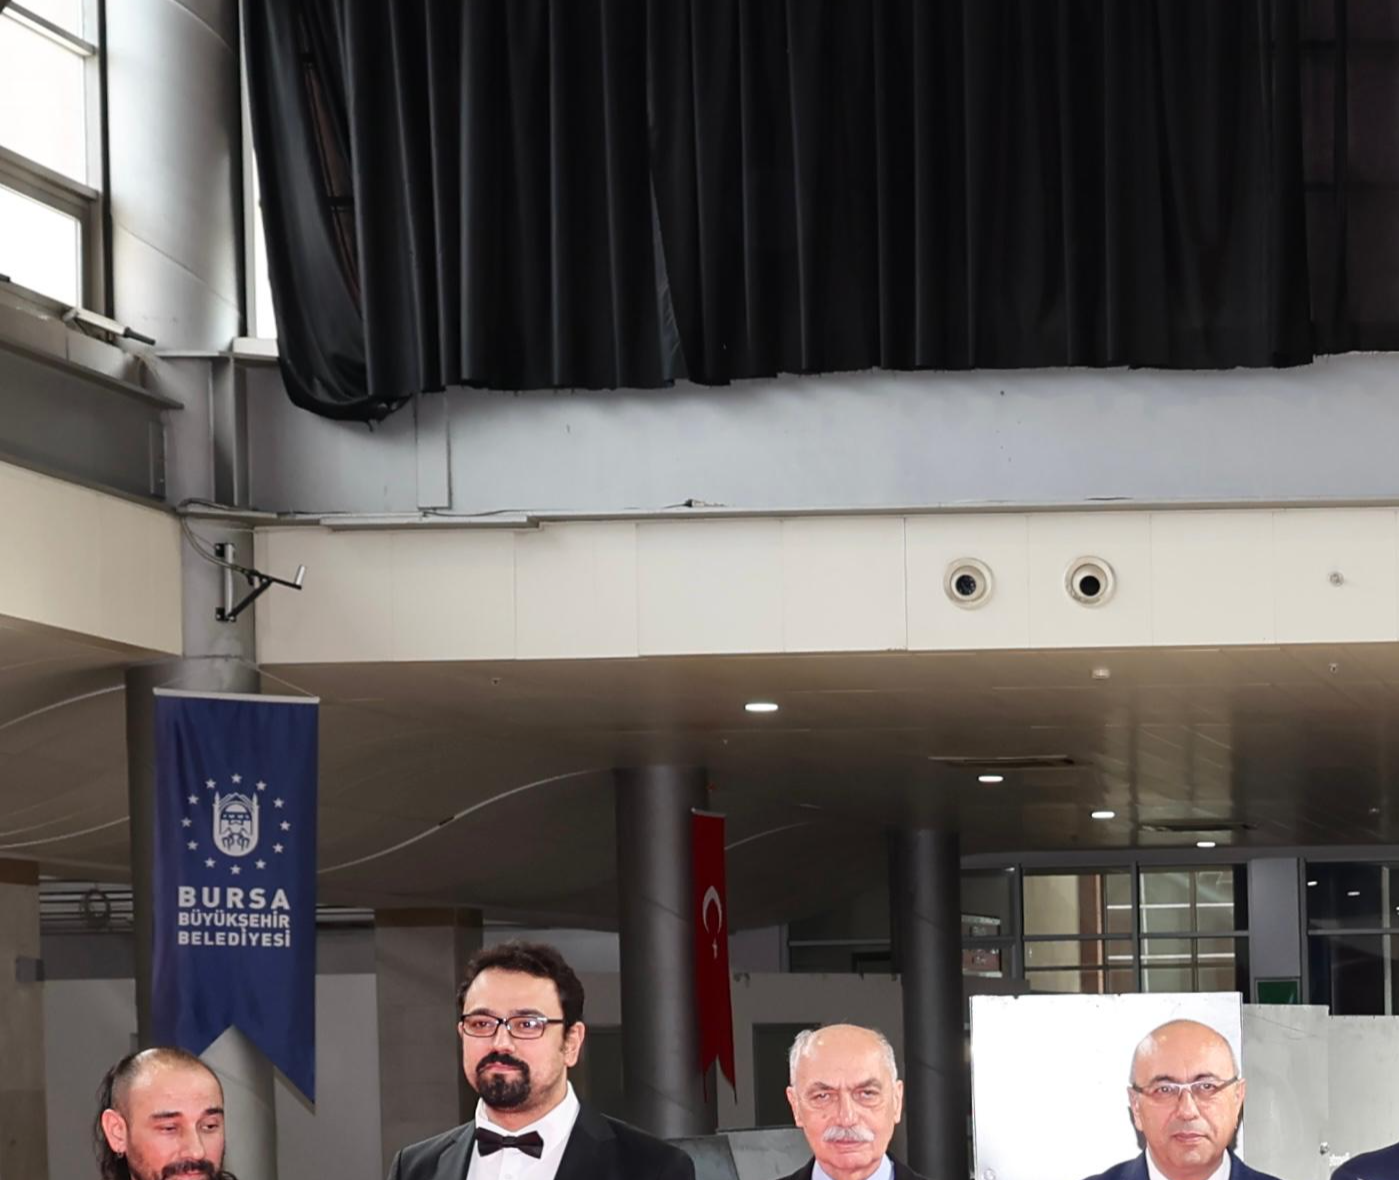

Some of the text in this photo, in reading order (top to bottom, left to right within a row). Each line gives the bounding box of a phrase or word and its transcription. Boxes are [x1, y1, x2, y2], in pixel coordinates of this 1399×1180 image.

[178, 886, 291, 910] BURSA
[178, 909, 291, 930] BÜYÜKŞEHİR
[178, 928, 291, 947] BELEDİYESİ
